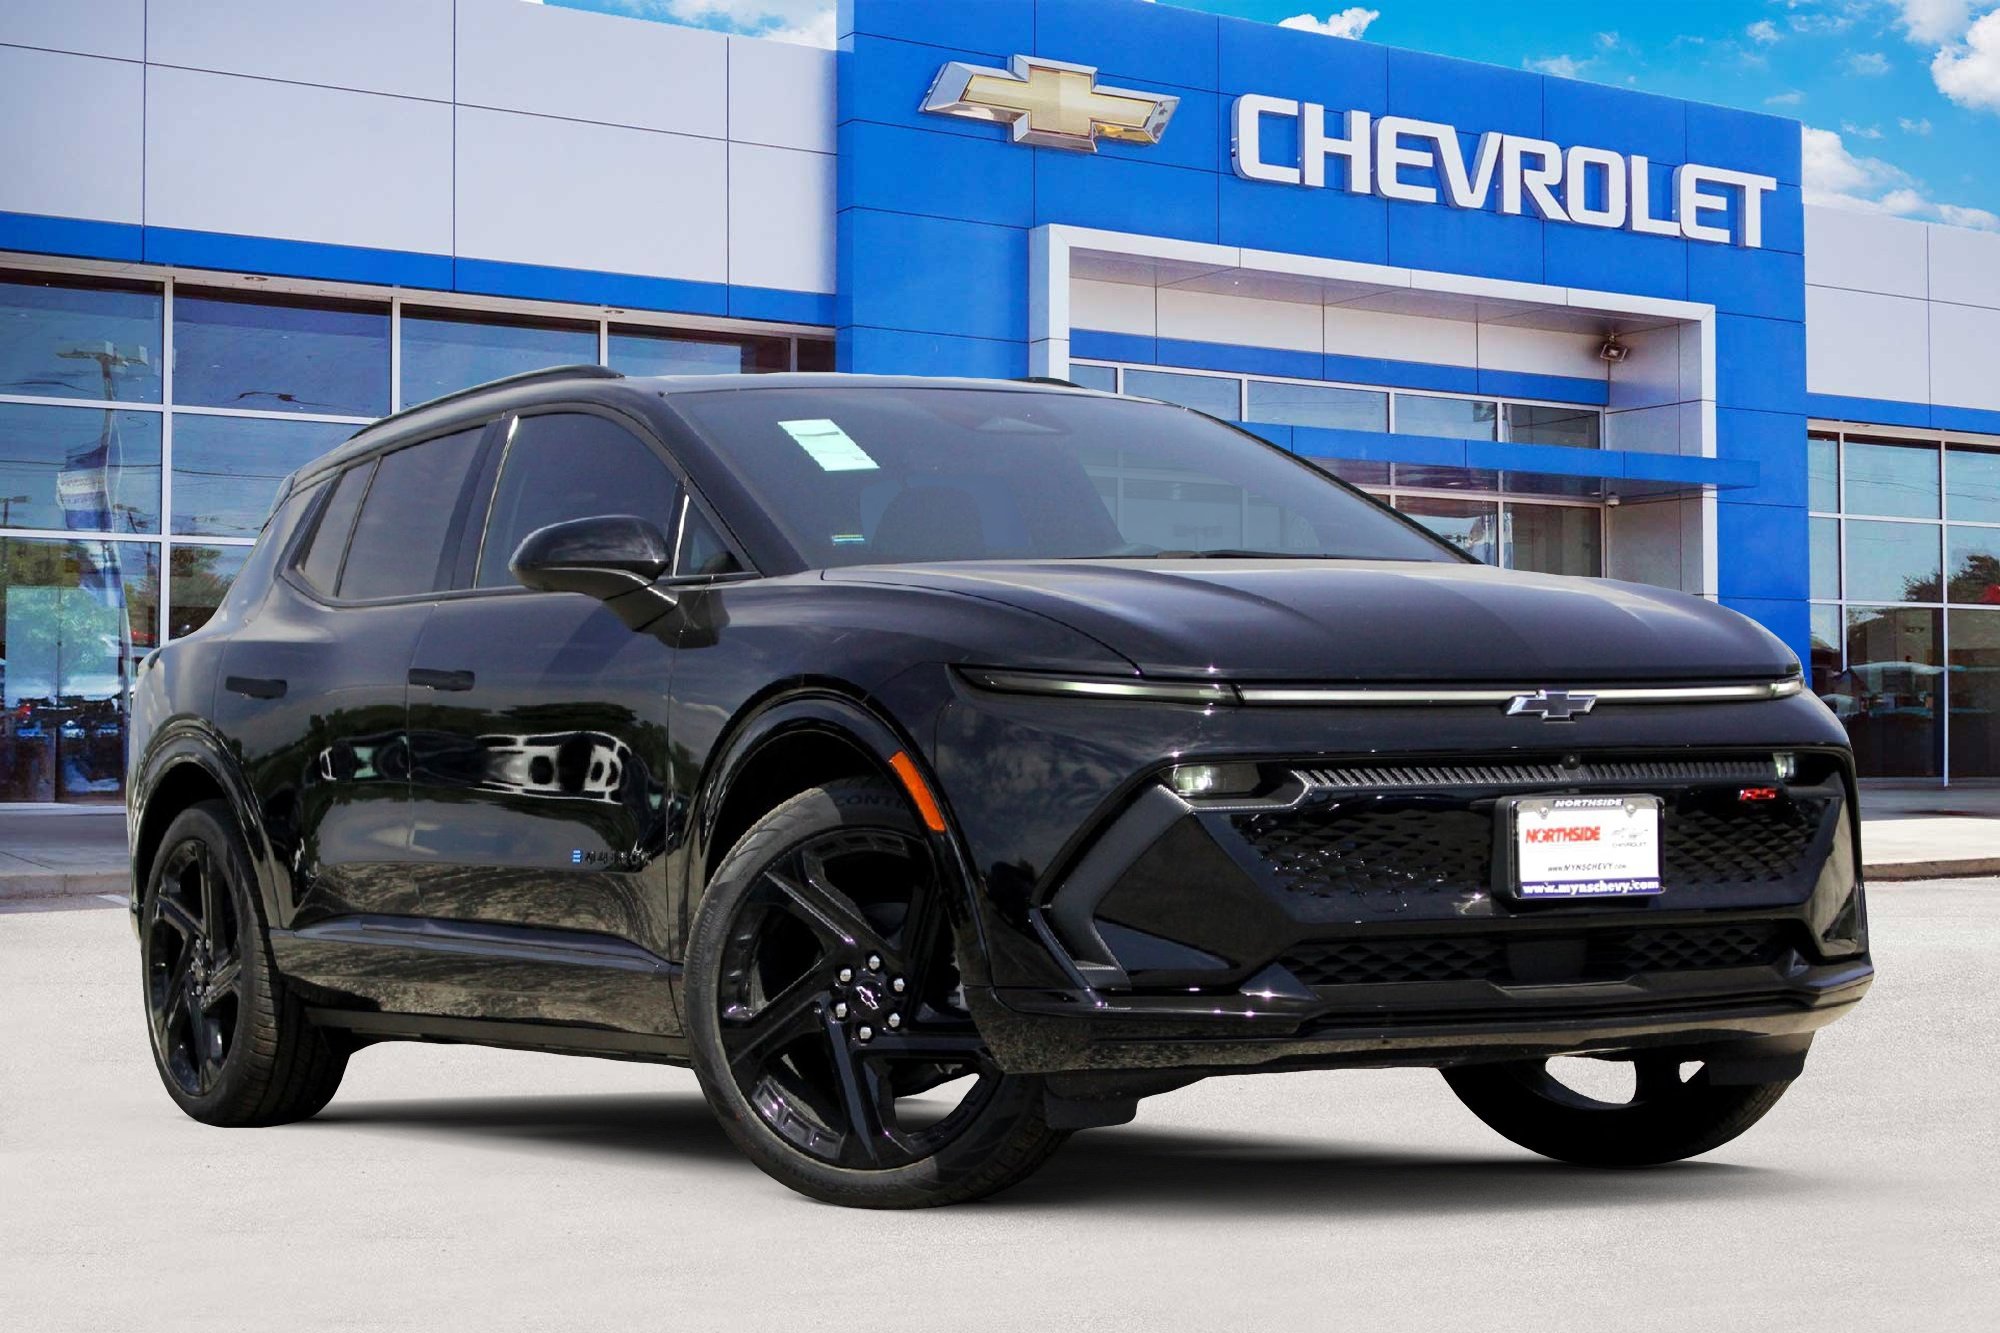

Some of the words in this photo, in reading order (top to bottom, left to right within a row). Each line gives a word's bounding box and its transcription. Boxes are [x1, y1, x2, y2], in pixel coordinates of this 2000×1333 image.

[1231, 93, 1777, 249] CHEVROLET
[1555, 798, 1623, 808] NORTHSIDE
[1525, 826, 1601, 844] NORTHSIDE
[1522, 880, 1660, 896] www.mynschevy.com
